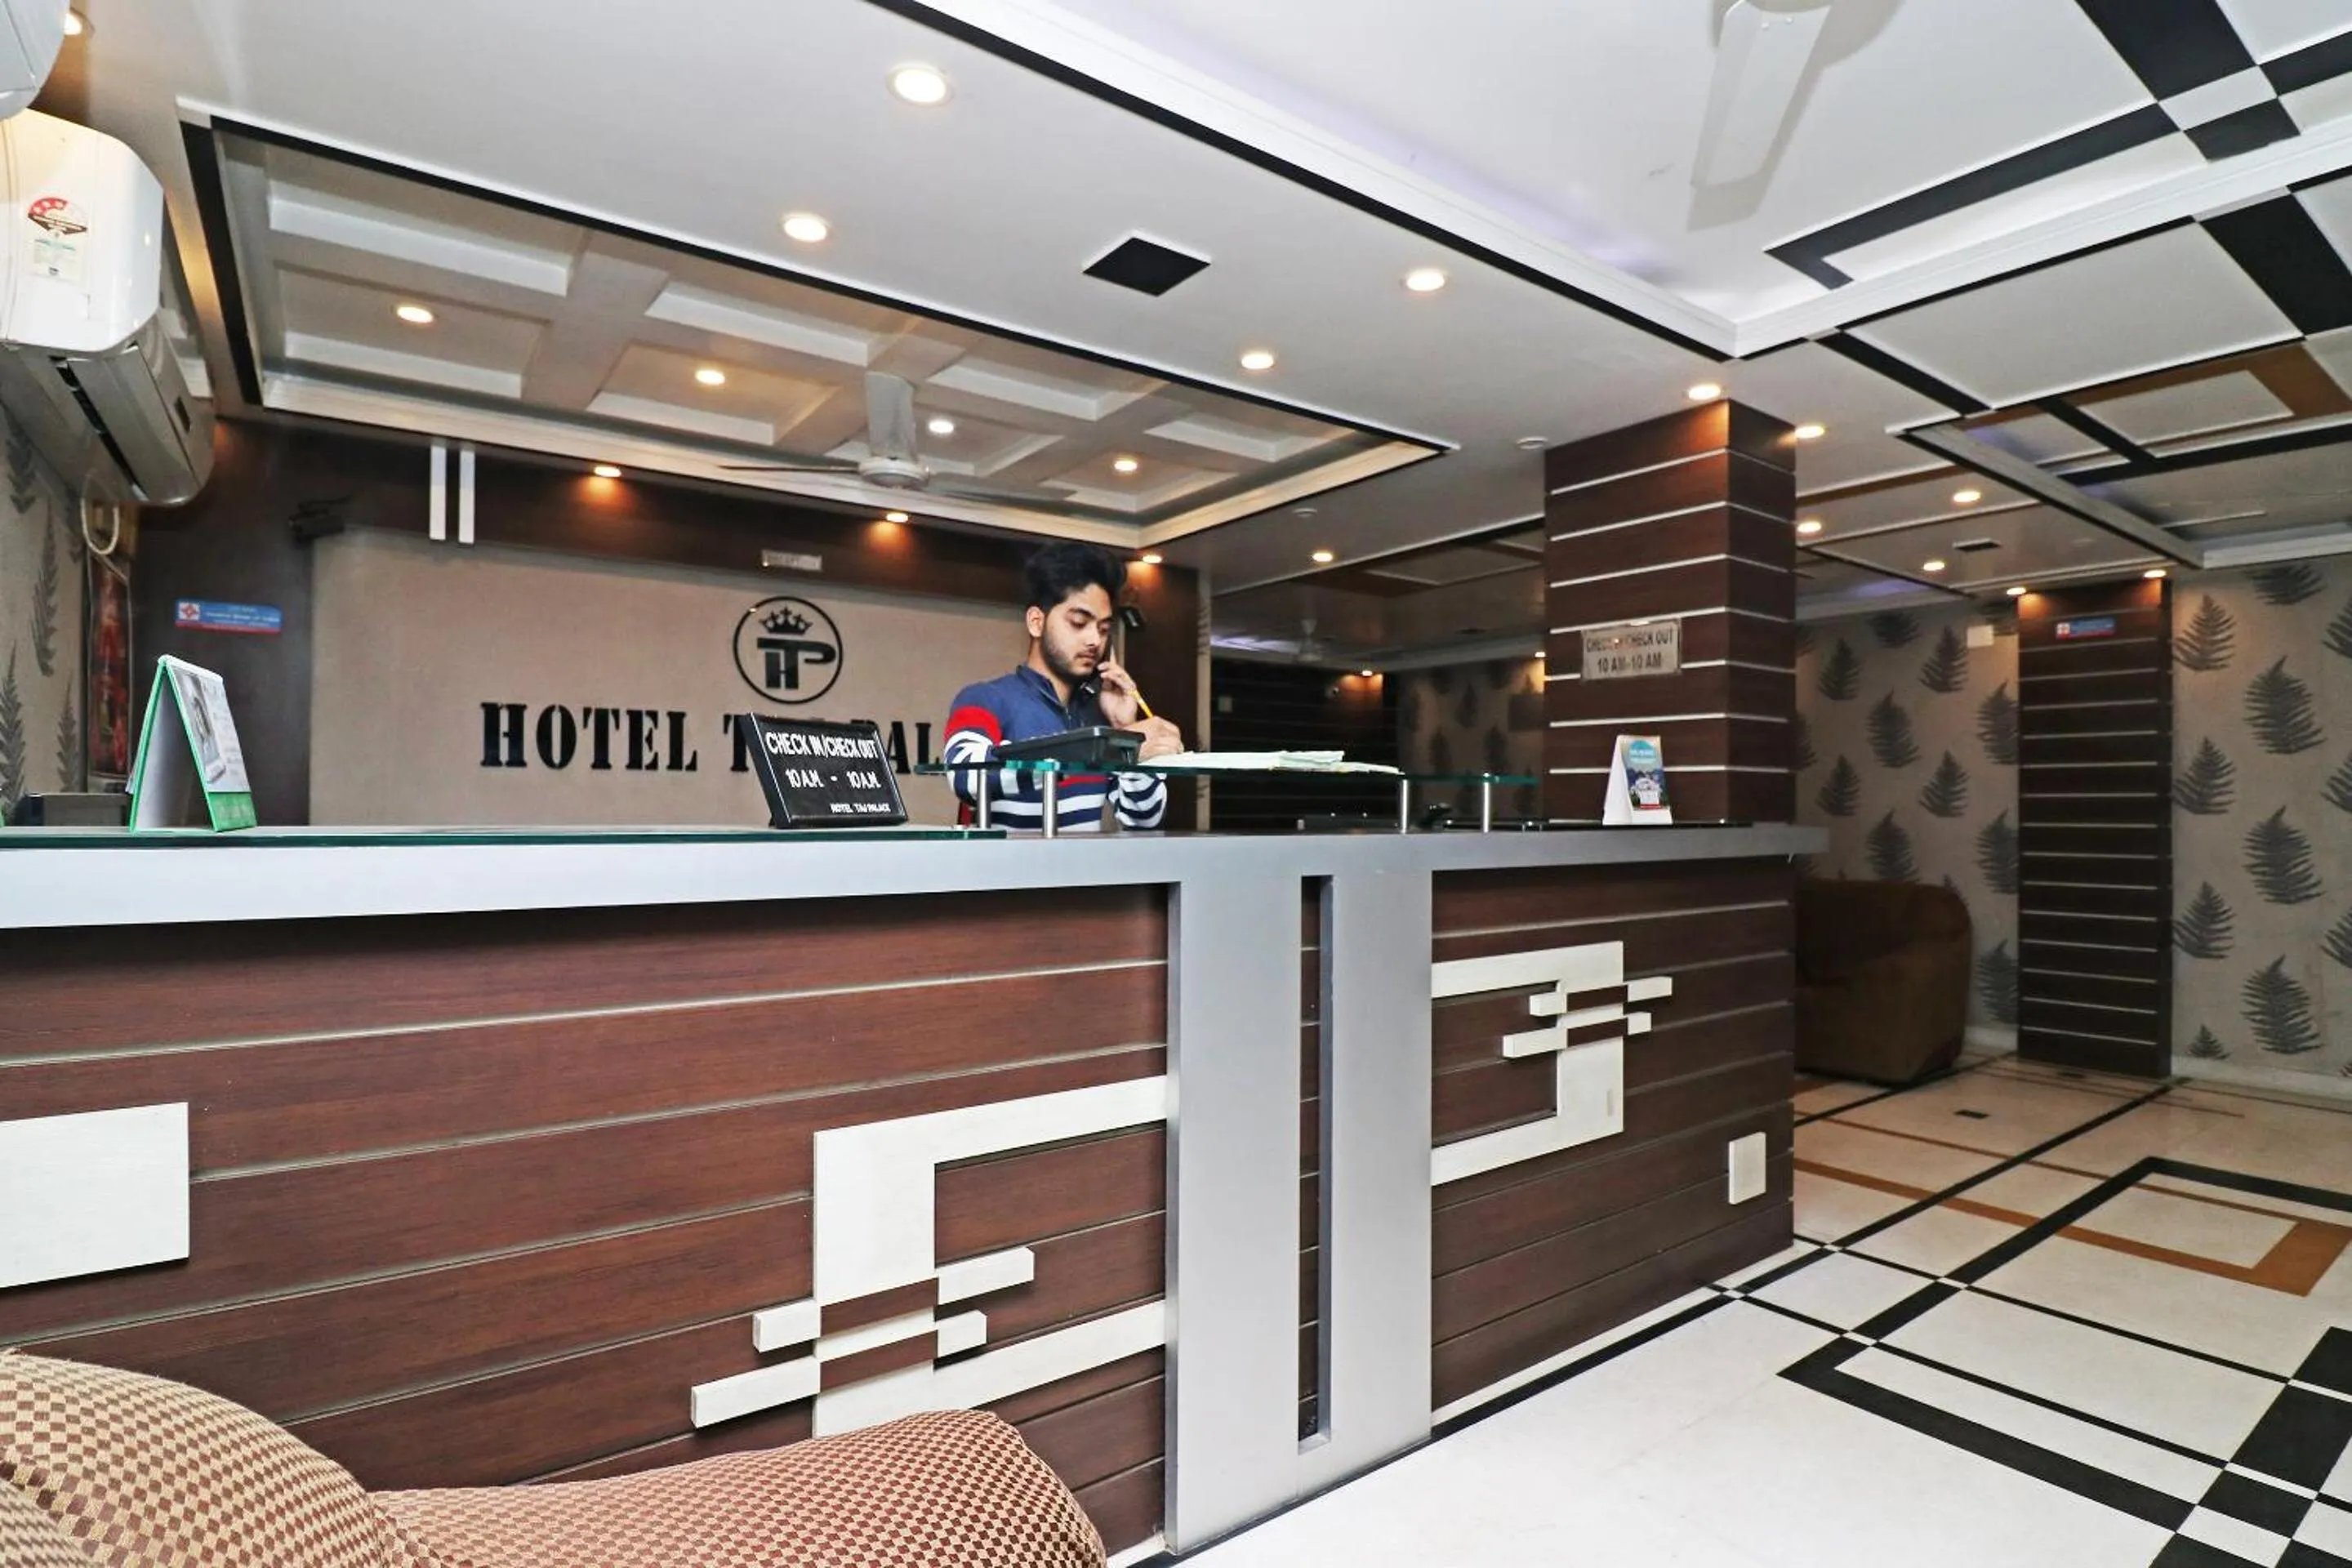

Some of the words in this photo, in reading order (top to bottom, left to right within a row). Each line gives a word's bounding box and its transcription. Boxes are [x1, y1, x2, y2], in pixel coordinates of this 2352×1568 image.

[1655, 626, 1673, 645] OUT
[479, 702, 697, 770] HOTEL
[766, 732, 811, 755] CHECK
[858, 738, 879, 759] OUT
